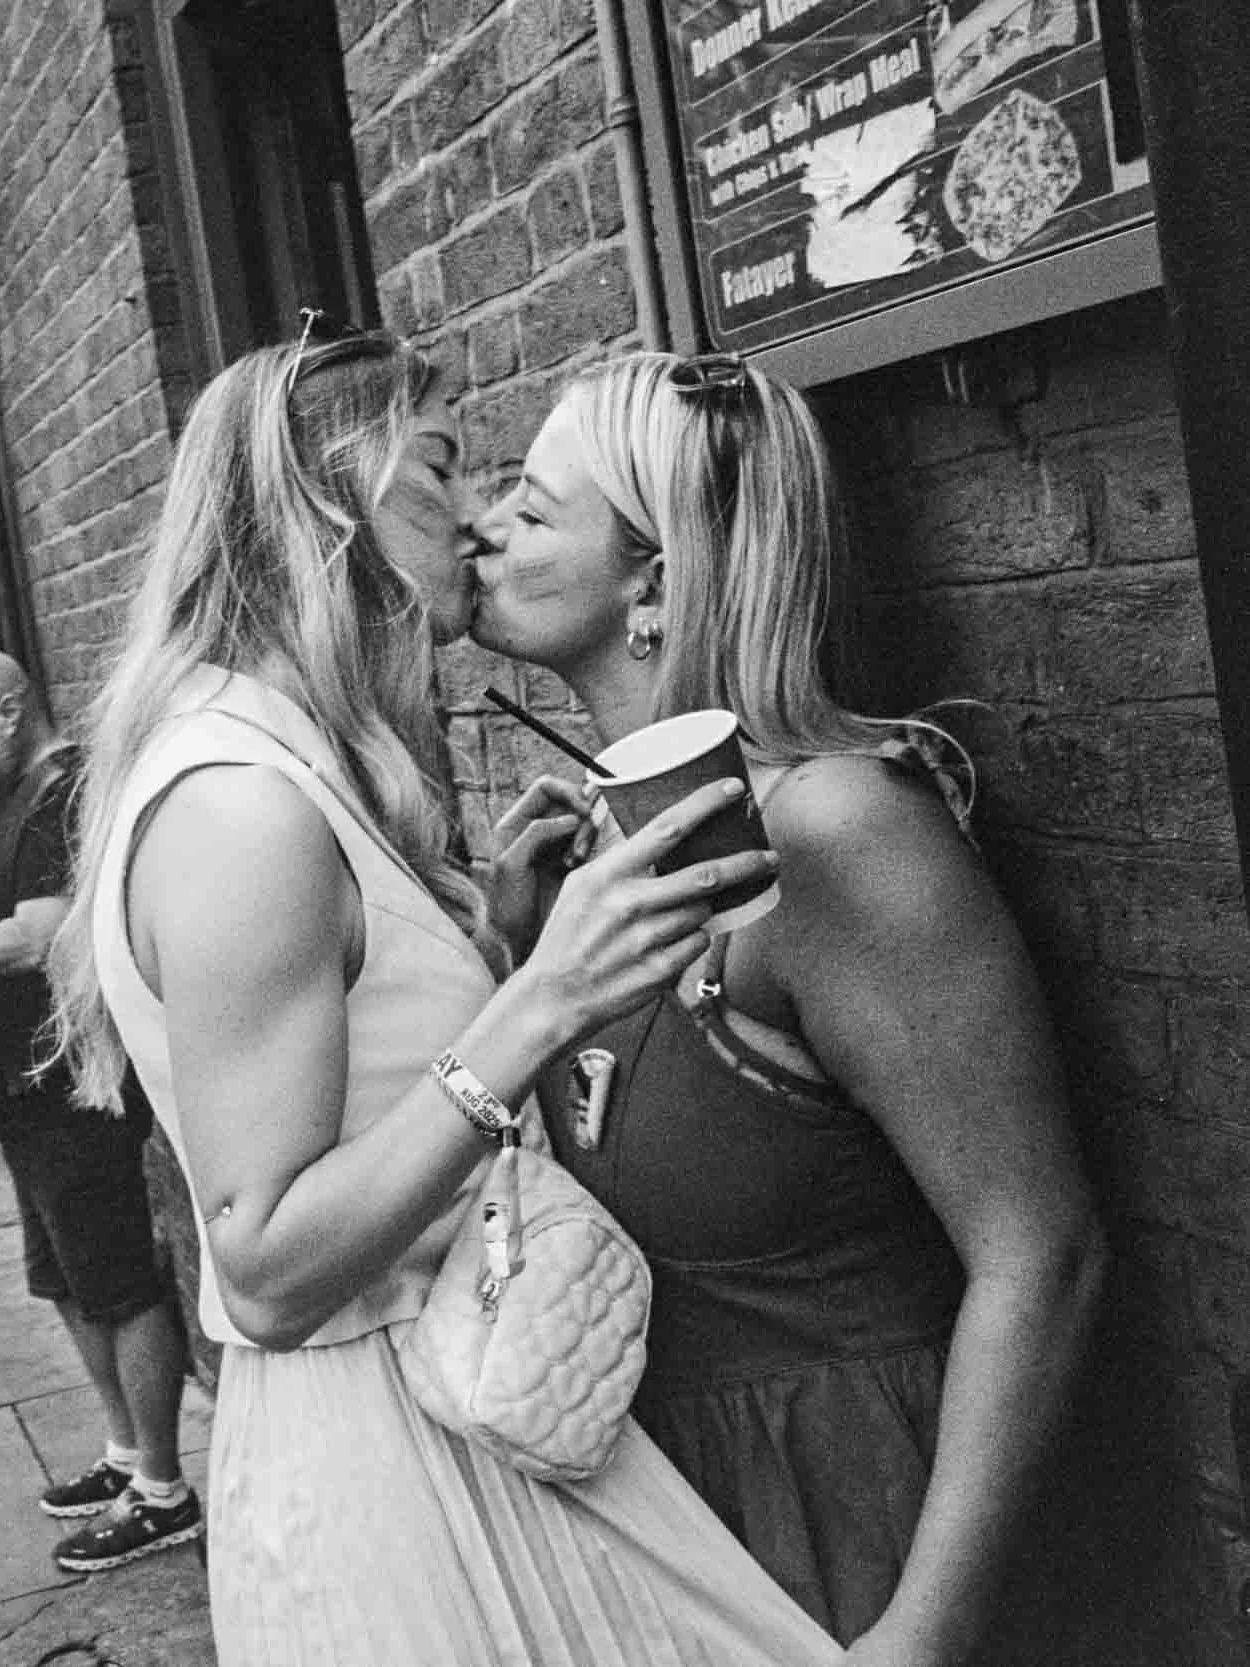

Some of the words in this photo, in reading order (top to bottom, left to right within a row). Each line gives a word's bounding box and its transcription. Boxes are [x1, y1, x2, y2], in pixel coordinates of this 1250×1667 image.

[815, 72, 867, 120] Wrap
[869, 37, 920, 93] Meal
[721, 250, 795, 309] Fatayer
